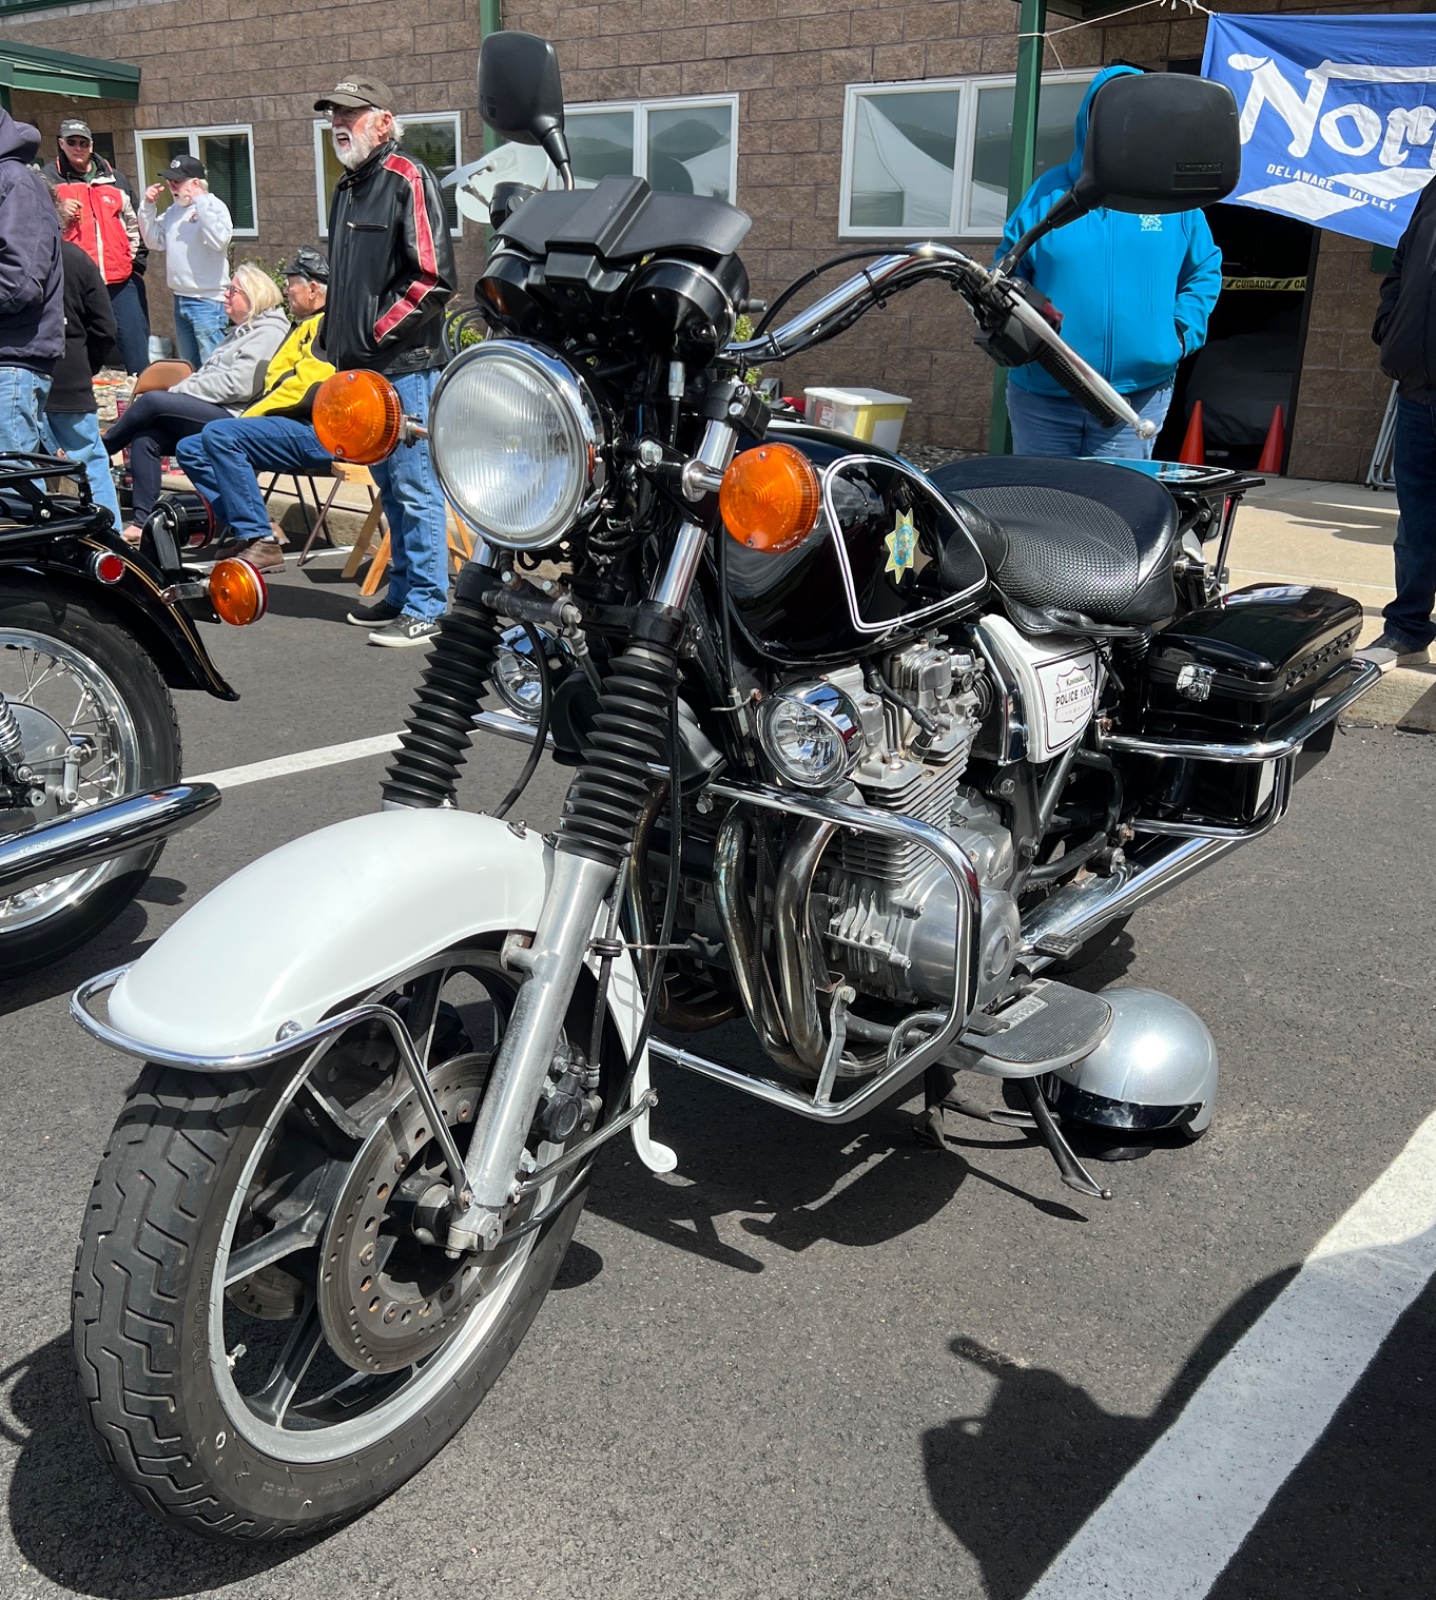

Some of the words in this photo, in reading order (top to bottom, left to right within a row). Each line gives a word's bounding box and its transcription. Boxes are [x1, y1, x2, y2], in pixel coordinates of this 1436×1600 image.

[1228, 53, 1436, 169] Nor
[1266, 163, 1335, 191] DELAWARE
[1349, 188, 1397, 212] VALLEY
[1235, 280, 1271, 289] CUIDADO
[1055, 690, 1079, 707] POLICE
